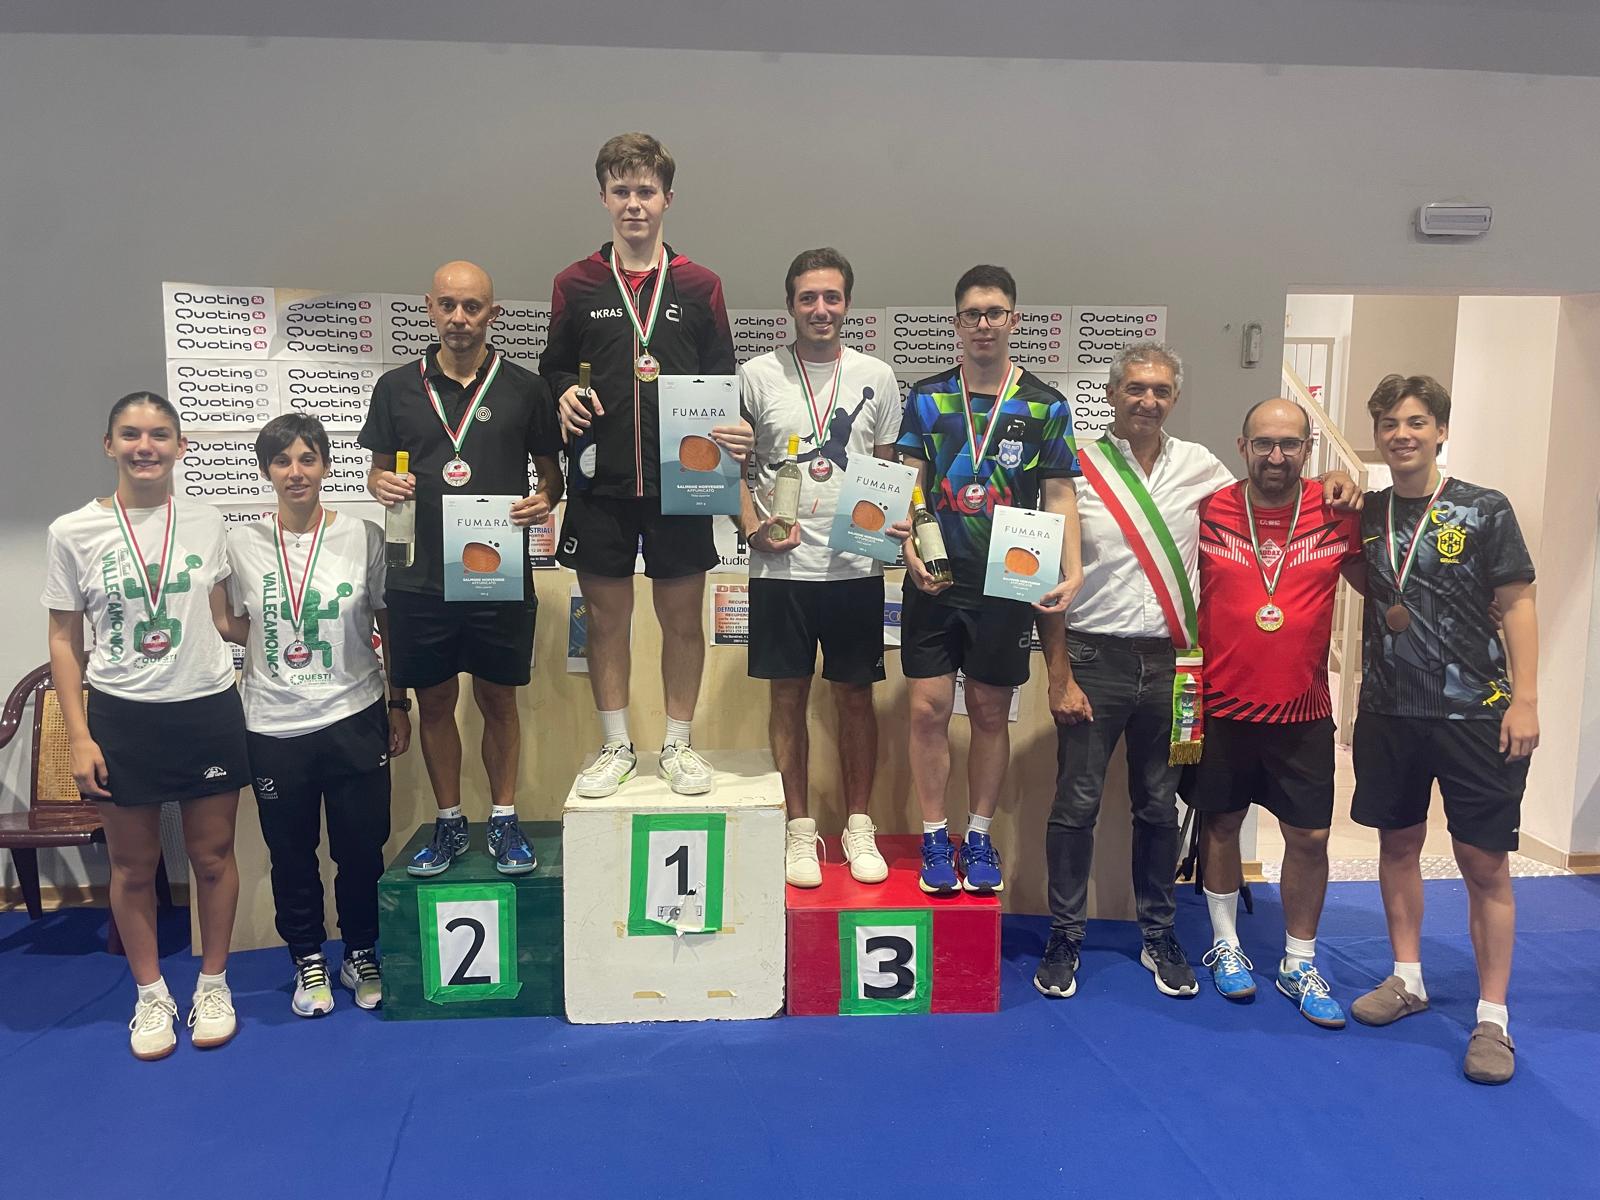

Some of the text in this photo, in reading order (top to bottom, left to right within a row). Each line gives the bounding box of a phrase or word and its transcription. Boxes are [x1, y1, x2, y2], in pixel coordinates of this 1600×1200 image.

[174, 293, 249, 306] Quoting
[289, 301, 356, 311] Quoting
[176, 308, 250, 321] Quoting
[597, 308, 623, 319] KRAS
[1080, 313, 1144, 324] Quoting
[287, 314, 357, 325] Quoting
[392, 317, 436, 327] Quot
[176, 324, 251, 336] Quoting
[287, 327, 357, 339] Quoting
[894, 328, 955, 337] Quoting
[1079, 327, 1142, 338] Quoting
[178, 339, 252, 351] Quoting
[491, 335, 546, 346] Quotin
[894, 341, 954, 351] Quoting
[1008, 341, 1047, 350] oting
[288, 341, 358, 354] Quoting
[893, 355, 954, 365] Quoting
[1009, 354, 1046, 364] oting
[178, 367, 252, 379] Quoting
[289, 369, 359, 380] Quoting
[179, 382, 253, 394] Quoting
[290, 384, 360, 394] Quoting
[180, 397, 254, 408] Quoting
[291, 398, 361, 408] Quoting
[181, 412, 254, 422] Quoting
[672, 408, 726, 416] FUMARA
[1075, 408, 1115, 417] Quot
[184, 457, 257, 467] Quoting
[185, 471, 258, 482] Quoting
[857, 476, 900, 493] FUMARA
[186, 486, 259, 496] Quoting
[1005, 526, 1050, 539] FUMARA
[102, 551, 124, 663] VALLECAMONICA
[263, 572, 279, 678] VALLECAMONICA
[666, 846, 696, 895] 1
[445, 918, 491, 985] 2
[864, 936, 915, 999] 3
